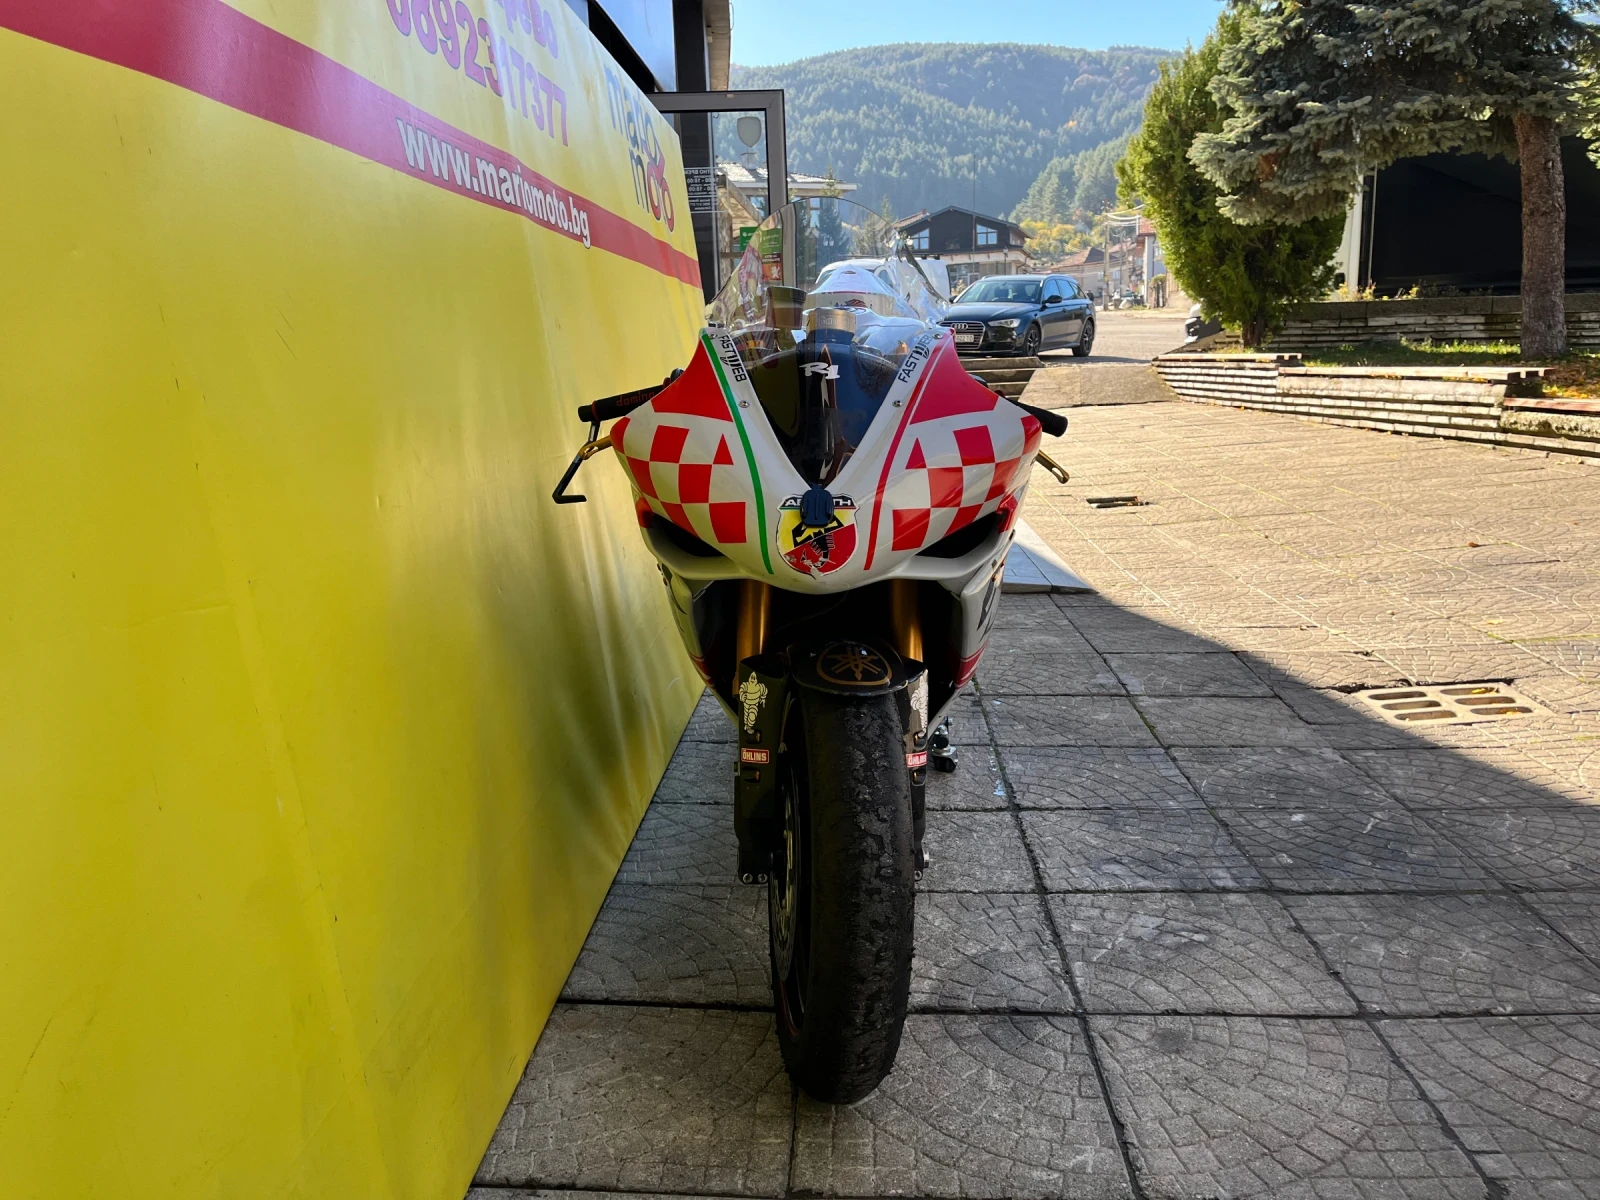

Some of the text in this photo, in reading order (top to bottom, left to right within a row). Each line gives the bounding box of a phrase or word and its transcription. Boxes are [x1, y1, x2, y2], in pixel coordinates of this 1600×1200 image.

[396, 116, 591, 249] www.mariomoto.bg
[718, 334, 748, 383] FASTWEB
[799, 361, 841, 379] R1
[742, 749, 767, 762] ÖHLINS
